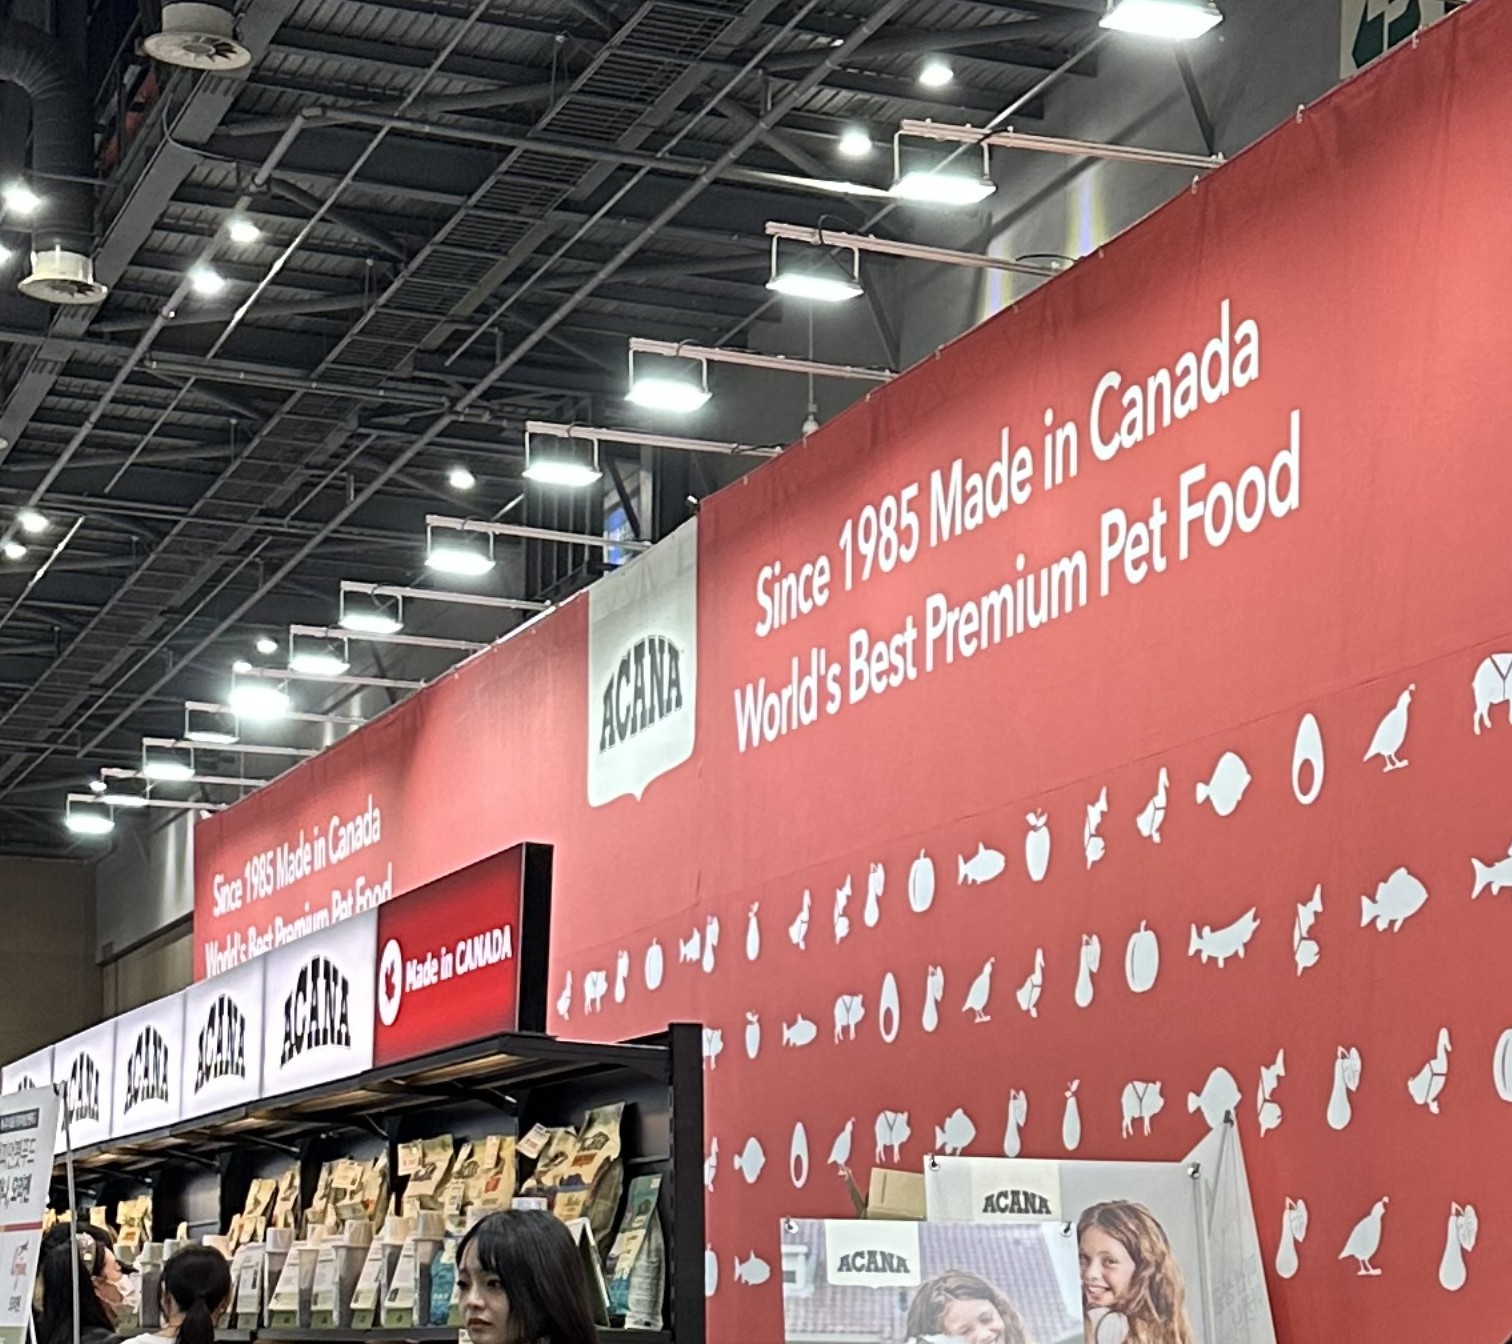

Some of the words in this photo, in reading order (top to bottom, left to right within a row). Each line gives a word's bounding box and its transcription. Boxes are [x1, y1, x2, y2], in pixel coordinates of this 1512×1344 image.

[755, 559, 830, 637] Since
[839, 483, 921, 591] 1985
[929, 428, 1032, 548] Made
[1042, 408, 1079, 489] in
[1090, 299, 1260, 462] Canada
[733, 648, 842, 753] World's
[848, 611, 918, 705] Best
[924, 553, 1090, 673] Premium
[1100, 496, 1168, 597] Pet
[1178, 409, 1301, 561] Food
[598, 633, 683, 754] ACANA
[212, 873, 242, 918] Since
[244, 850, 274, 902] 1985
[276, 830, 311, 891] Made
[313, 826, 327, 869] in
[328, 793, 381, 865] Canada
[204, 926, 247, 979] World's
[355, 862, 393, 917] Food
[405, 956, 438, 993] Made
[440, 947, 453, 981] in
[455, 925, 513, 975] CANADA
[124, 1024, 169, 1116] ACANA
[194, 993, 246, 1096] ACANA
[280, 954, 351, 1071] ACANA
[982, 1190, 1052, 1214] ACANA
[837, 1250, 910, 1273] ACANA
